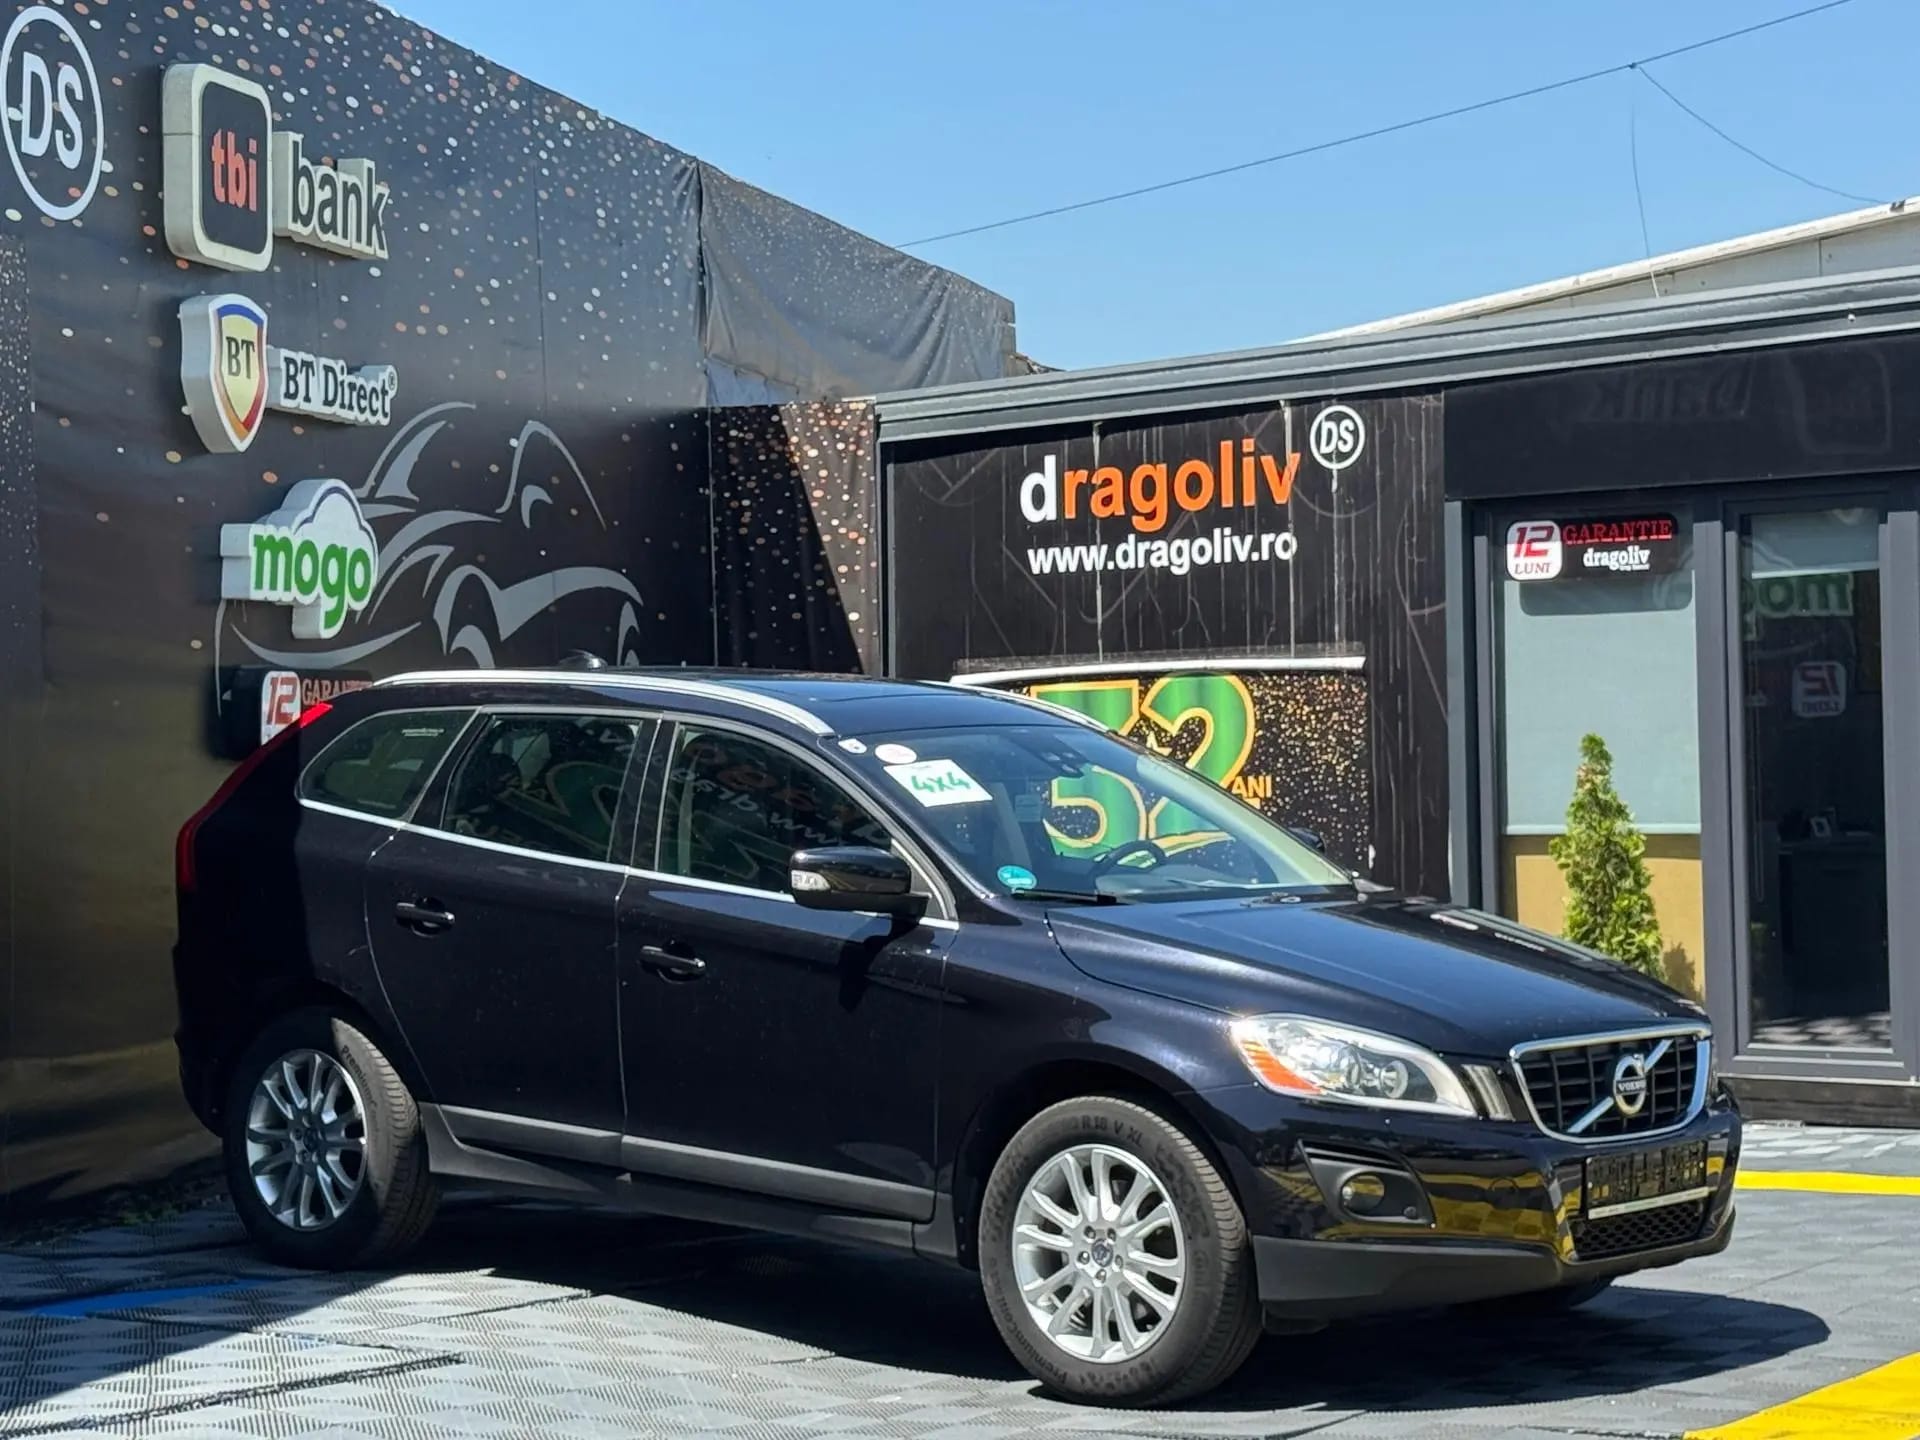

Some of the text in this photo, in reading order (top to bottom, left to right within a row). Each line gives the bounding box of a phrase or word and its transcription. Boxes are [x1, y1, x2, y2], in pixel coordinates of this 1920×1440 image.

[21, 52, 83, 170] DS
[211, 128, 257, 212] tbi
[291, 140, 386, 259] bank
[226, 336, 255, 379] BT
[284, 356, 315, 403] BT
[1319, 414, 1354, 454] DS
[1019, 437, 1300, 533] dragoliv
[1027, 527, 1298, 576] www.dragoliv.ro
[1514, 520, 1673, 558] 12 GARANTIE
[1583, 545, 1650, 571] dragoliv
[253, 533, 371, 630] mogo
[1514, 562, 1552, 575] LUNI
[266, 676, 298, 725] 12
[1231, 774, 1273, 799] ANI
